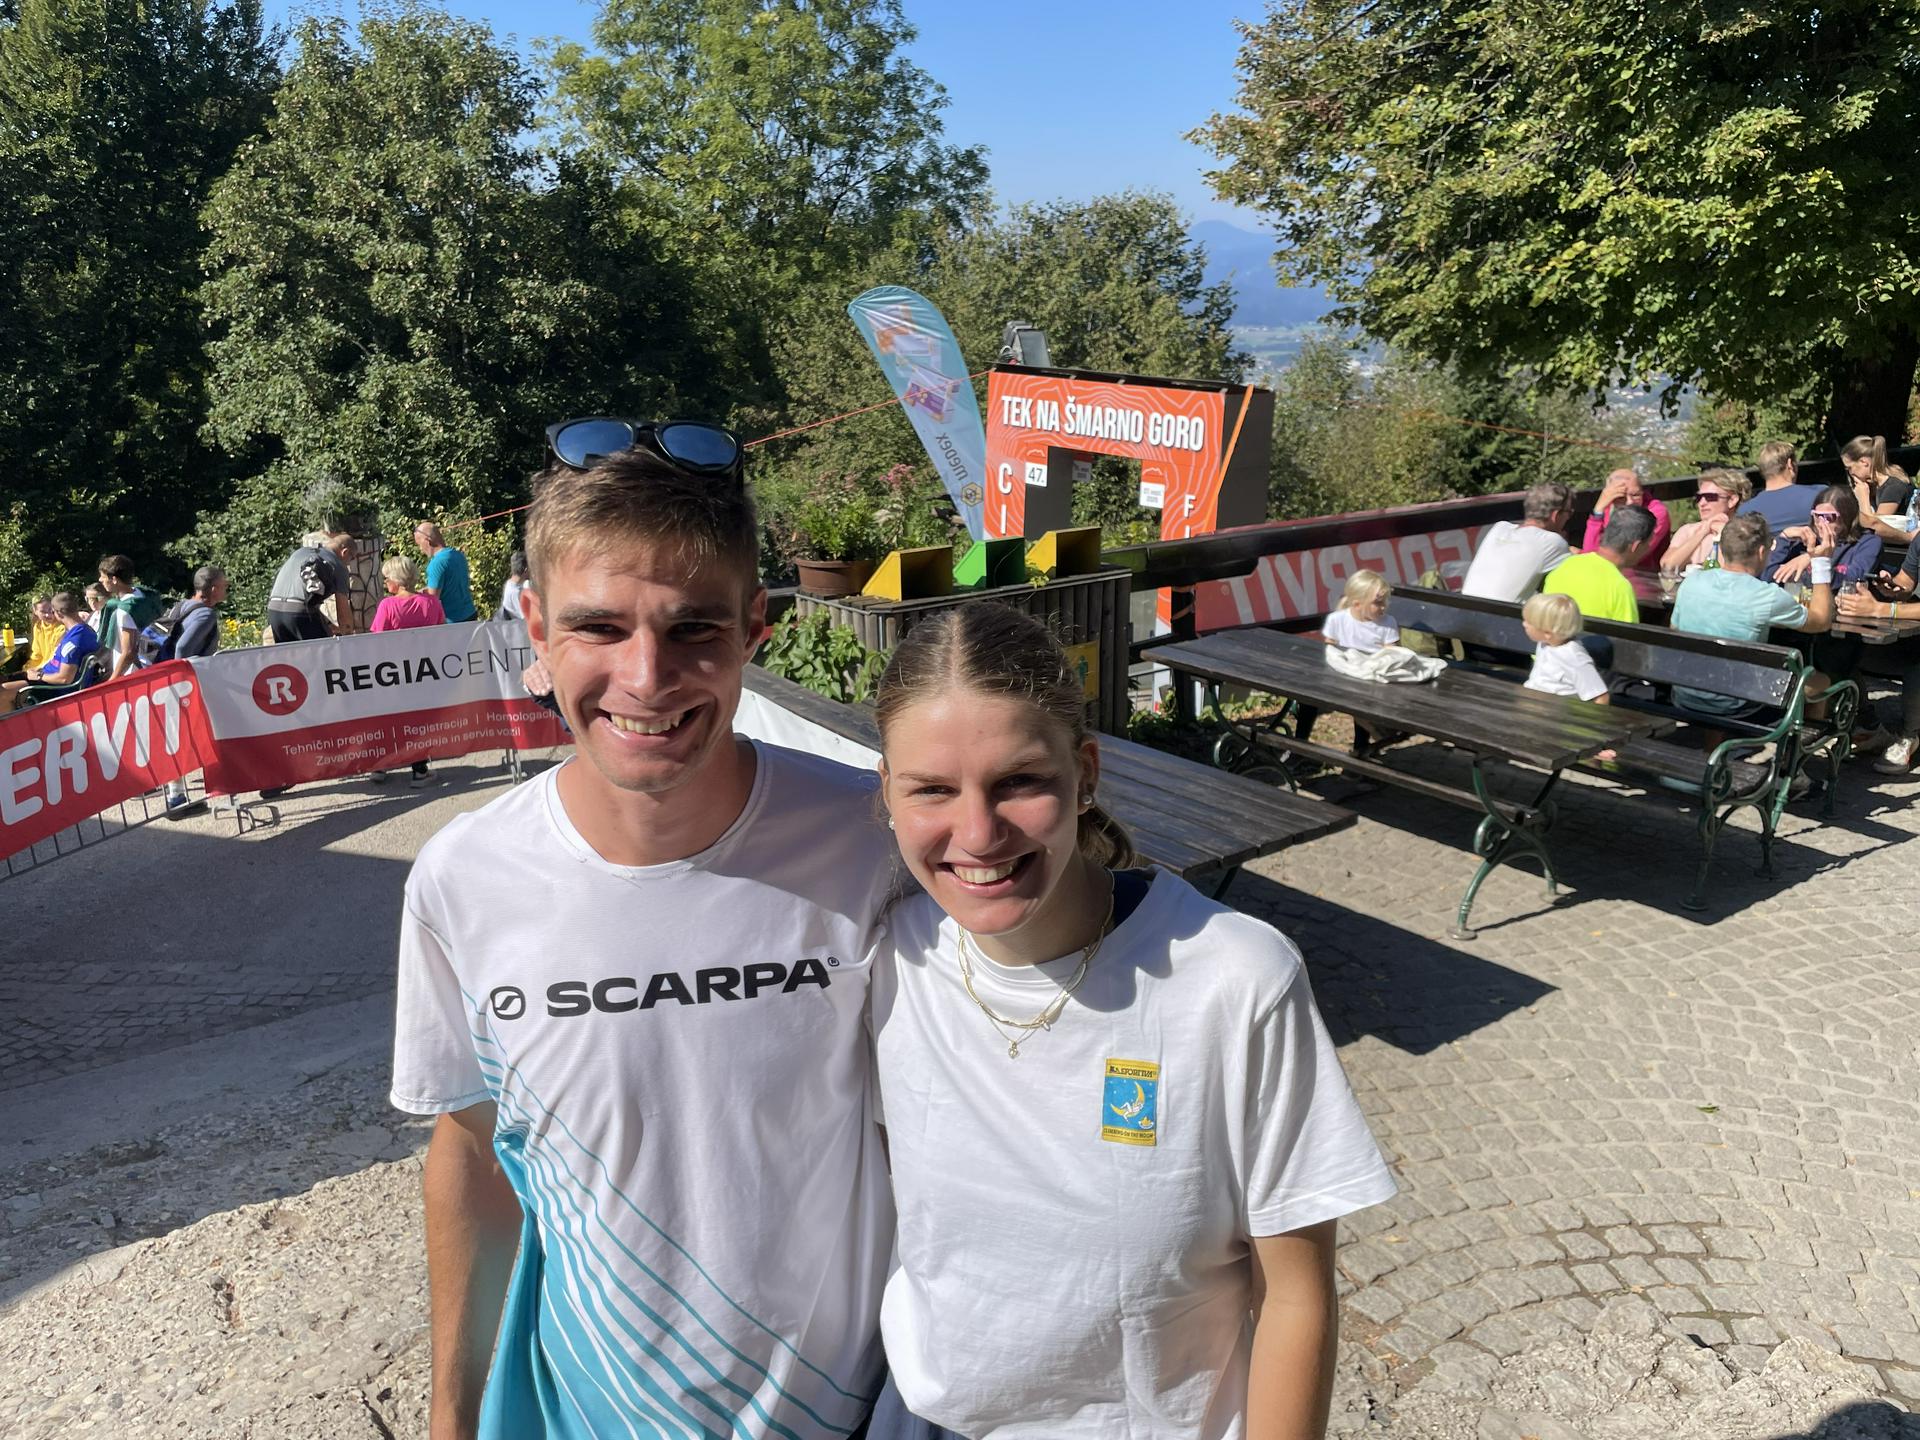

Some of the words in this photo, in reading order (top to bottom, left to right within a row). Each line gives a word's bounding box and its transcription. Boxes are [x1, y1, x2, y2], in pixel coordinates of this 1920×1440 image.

[1001, 395, 1033, 429] TEK
[1036, 399, 1061, 432] NA
[1064, 395, 1144, 443] ŠMARNO
[1149, 411, 1205, 451] GORO
[1028, 466, 1045, 484] 47.
[324, 646, 538, 695] REGIACENT
[282, 738, 334, 756] Tehnični
[336, 729, 385, 748] pregledi
[403, 717, 469, 736] Registracija
[315, 746, 387, 767] Zavarovanja
[405, 735, 449, 751] Prodaja
[451, 733, 461, 743] in
[463, 728, 495, 741] servis
[496, 727, 521, 737] vozil
